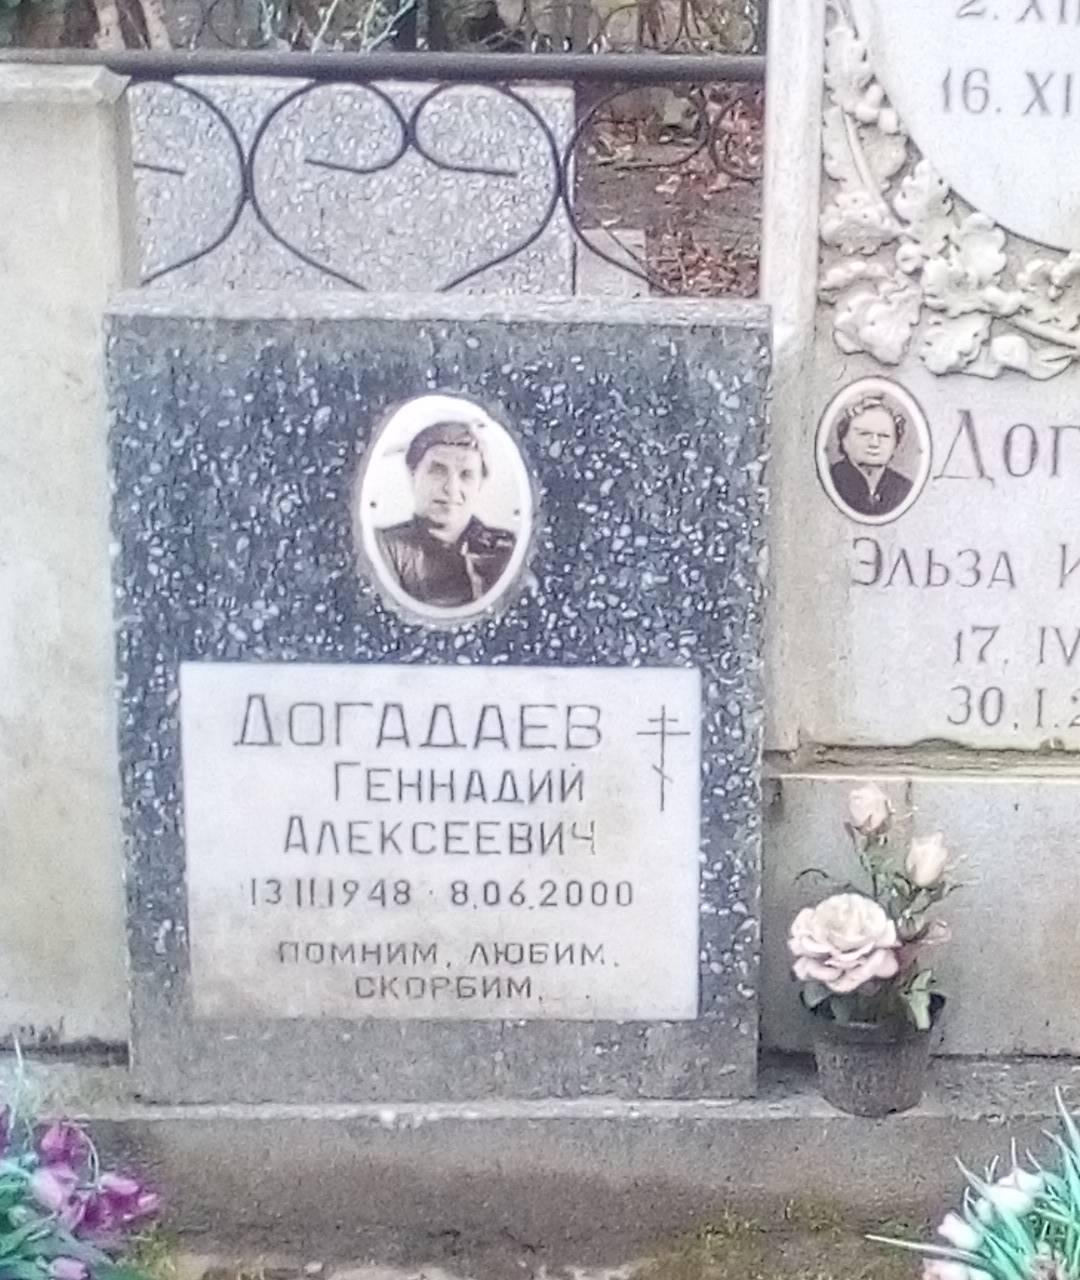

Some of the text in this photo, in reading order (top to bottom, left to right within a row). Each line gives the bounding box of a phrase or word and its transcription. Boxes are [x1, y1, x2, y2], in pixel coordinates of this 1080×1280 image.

[851, 537, 1017, 590] ЭЛЬЗА
[233, 694, 603, 750] ДОГАДАЕВ
[333, 761, 585, 805] ГЕННАДИЙ
[284, 816, 597, 857] АЛЕКСЕЕВИЧ
